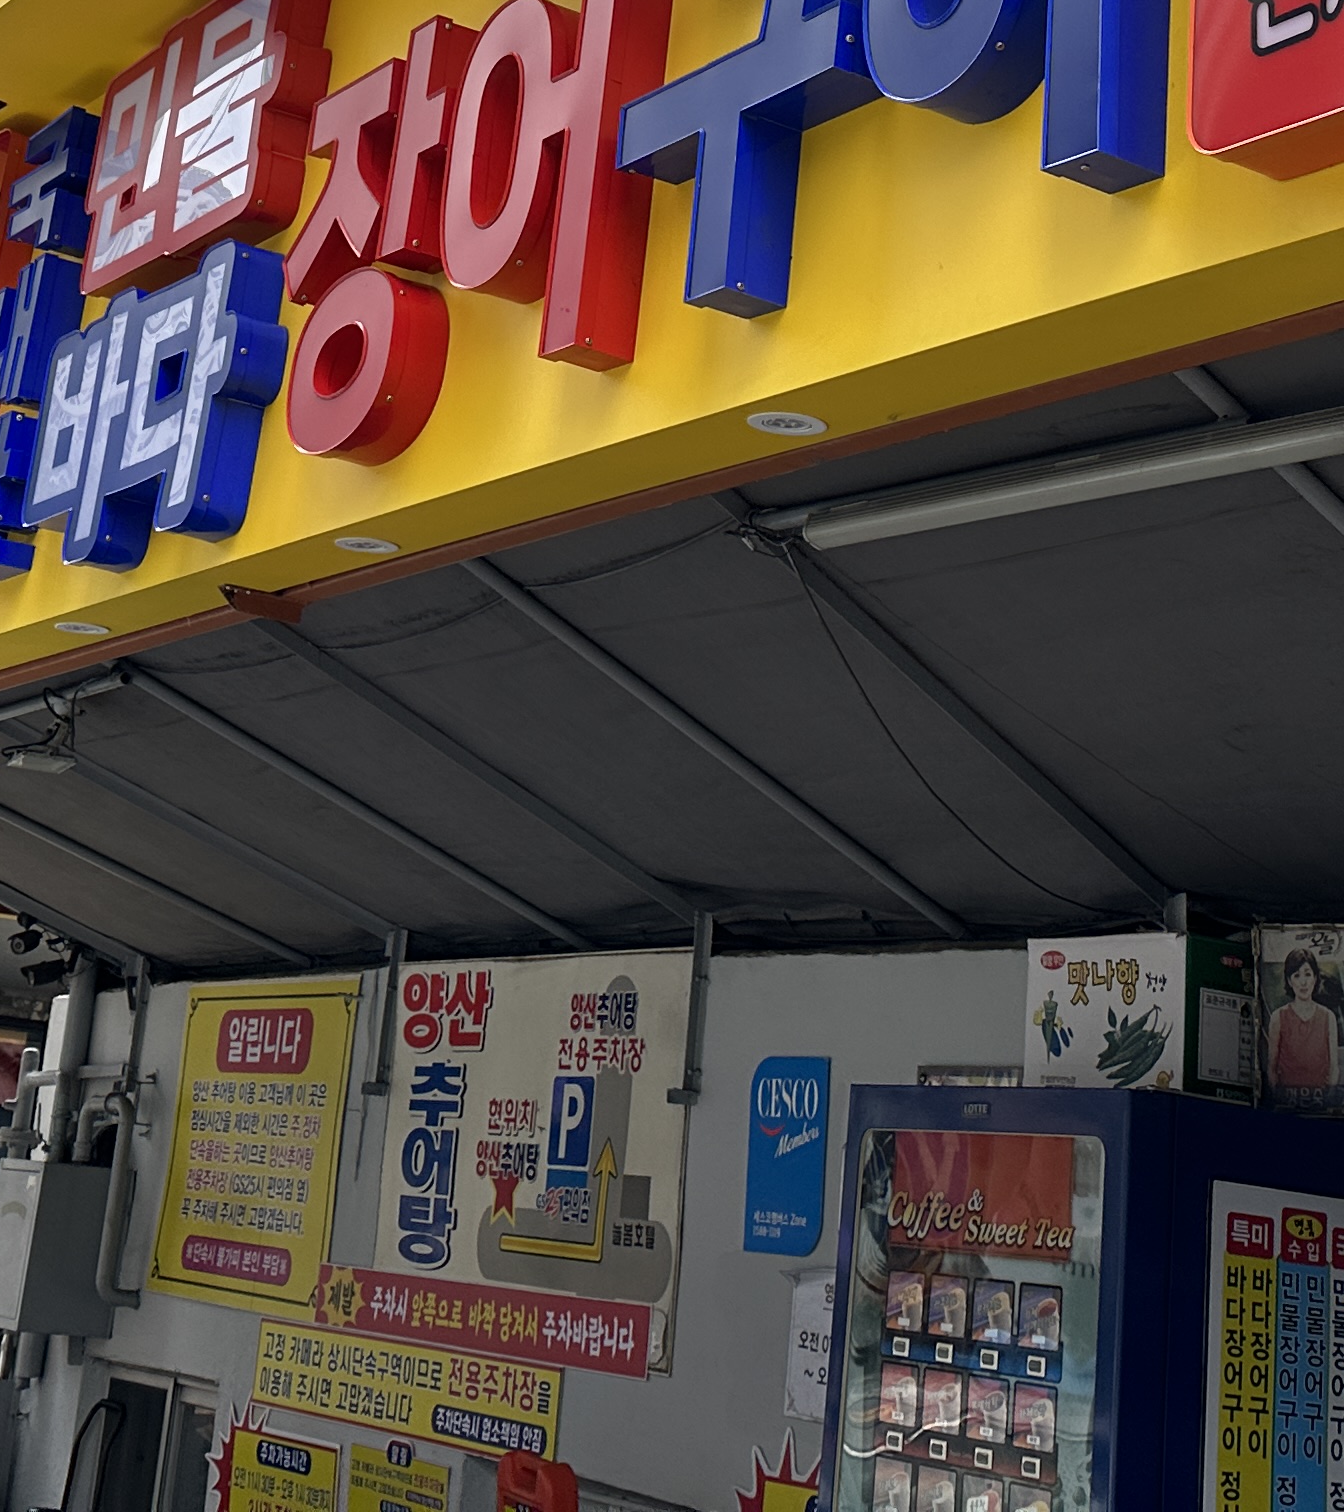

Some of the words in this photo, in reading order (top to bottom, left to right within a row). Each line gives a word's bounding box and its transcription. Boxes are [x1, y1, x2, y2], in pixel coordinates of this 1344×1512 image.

[30, 260, 231, 543] 바다
[1067, 958, 1140, 1006] 맛나향
[403, 970, 494, 1053] 양산
[569, 992, 639, 1031] 양산추어탕
[227, 1015, 302, 1064] 알립니다
[557, 1036, 646, 1074] 전용주차장
[192, 1079, 209, 1103] 양산
[211, 1080, 237, 1104] 추어탕
[239, 1081, 256, 1105] 이용
[296, 1084, 305, 1107] 이
[307, 1083, 327, 1107] 곳은
[757, 1077, 819, 1120] CESCO
[963, 1103, 988, 1114] LOTTE
[190, 1109, 232, 1133] 점심시간을
[261, 1112, 288, 1137] 시간은
[487, 1097, 538, 1137] 현위치
[558, 1083, 586, 1159] P
[232, 1141, 267, 1165] 곳이므로
[269, 1144, 315, 1172] 양산추어탕
[475, 1139, 541, 1182] 양산추어탕
[774, 1121, 819, 1159] Members
[186, 1167, 228, 1194] 전용주차장
[267, 1176, 294, 1202] 편의점
[398, 1059, 467, 1271] 추어탕
[181, 1197, 192, 1220] 꼭
[219, 1202, 246, 1227] 주시면
[887, 1190, 966, 1239] Coffee
[967, 1188, 984, 1212] &
[964, 1215, 1030, 1246] Sweet
[1033, 1218, 1076, 1249] Tea
[1230, 1218, 1269, 1251] 특미
[1286, 1240, 1321, 1263] 수입
[241, 1249, 261, 1273] 본인
[328, 1278, 356, 1318] 제발
[369, 1285, 408, 1326] 주차시
[410, 1291, 463, 1331] 앞쪽으로
[467, 1302, 496, 1335] 바짝
[498, 1306, 539, 1345] 당겨서
[542, 1311, 635, 1361] 주차바랍니다
[798, 1330, 820, 1353] 오전
[1221, 1264, 1247, 1458] 바다장어구이
[262, 1331, 285, 1362] 고정
[288, 1334, 325, 1370] 카메라
[327, 1340, 443, 1393] 상시단속구역이므로
[447, 1357, 552, 1416] 전용주차장을
[1247, 1267, 1273, 1460] 바다장어구이
[1276, 1271, 1301, 1463] 민물장어구이
[1301, 1274, 1327, 1466] 민물장어구이
[259, 1366, 293, 1402] 이용해
[296, 1373, 333, 1408] 주시면
[335, 1380, 413, 1427] 고맙겠습니다
[435, 1408, 479, 1440] 주차단속시
[481, 1417, 521, 1449] 업소책임
[259, 1441, 308, 1472] 주차가능시간
